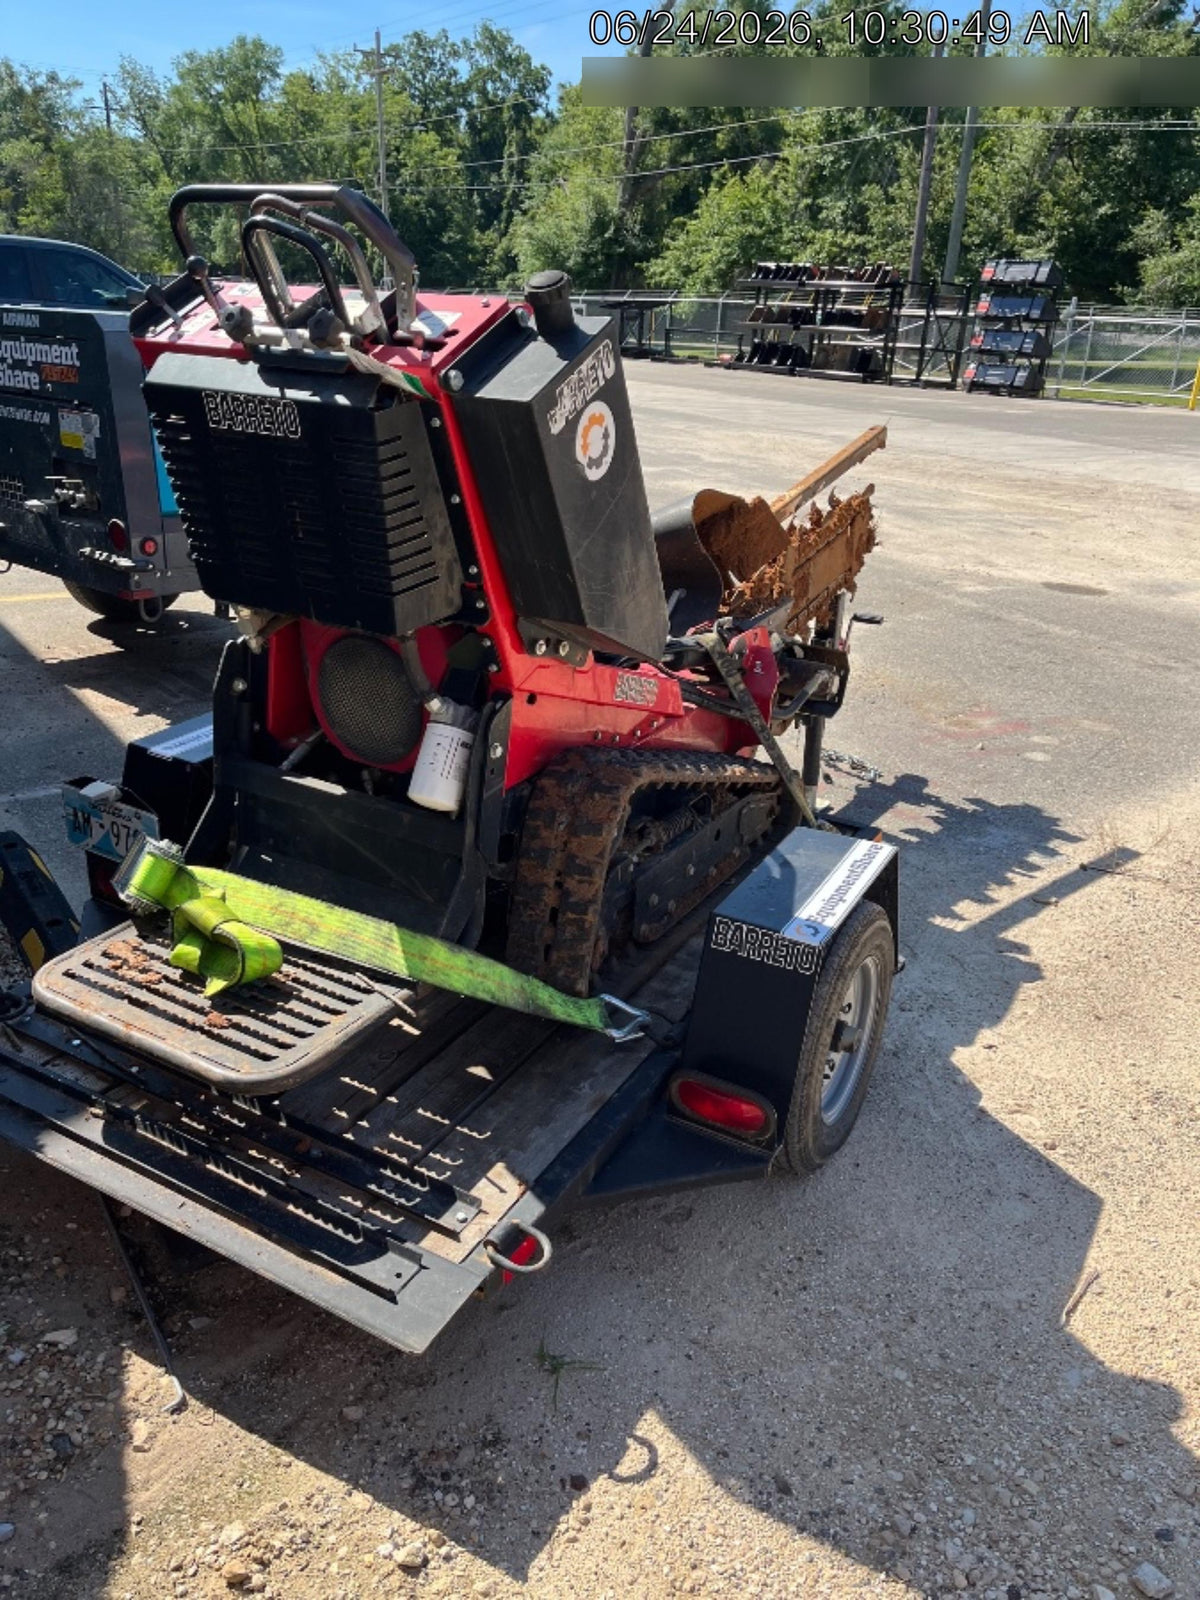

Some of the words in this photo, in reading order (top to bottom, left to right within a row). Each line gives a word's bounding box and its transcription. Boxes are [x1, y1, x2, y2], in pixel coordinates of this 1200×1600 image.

[0, 335, 80, 367] quipment
[202, 390, 301, 438] BARRETO
[805, 843, 883, 922] EquipmentShare
[711, 916, 817, 975] BARRETO
